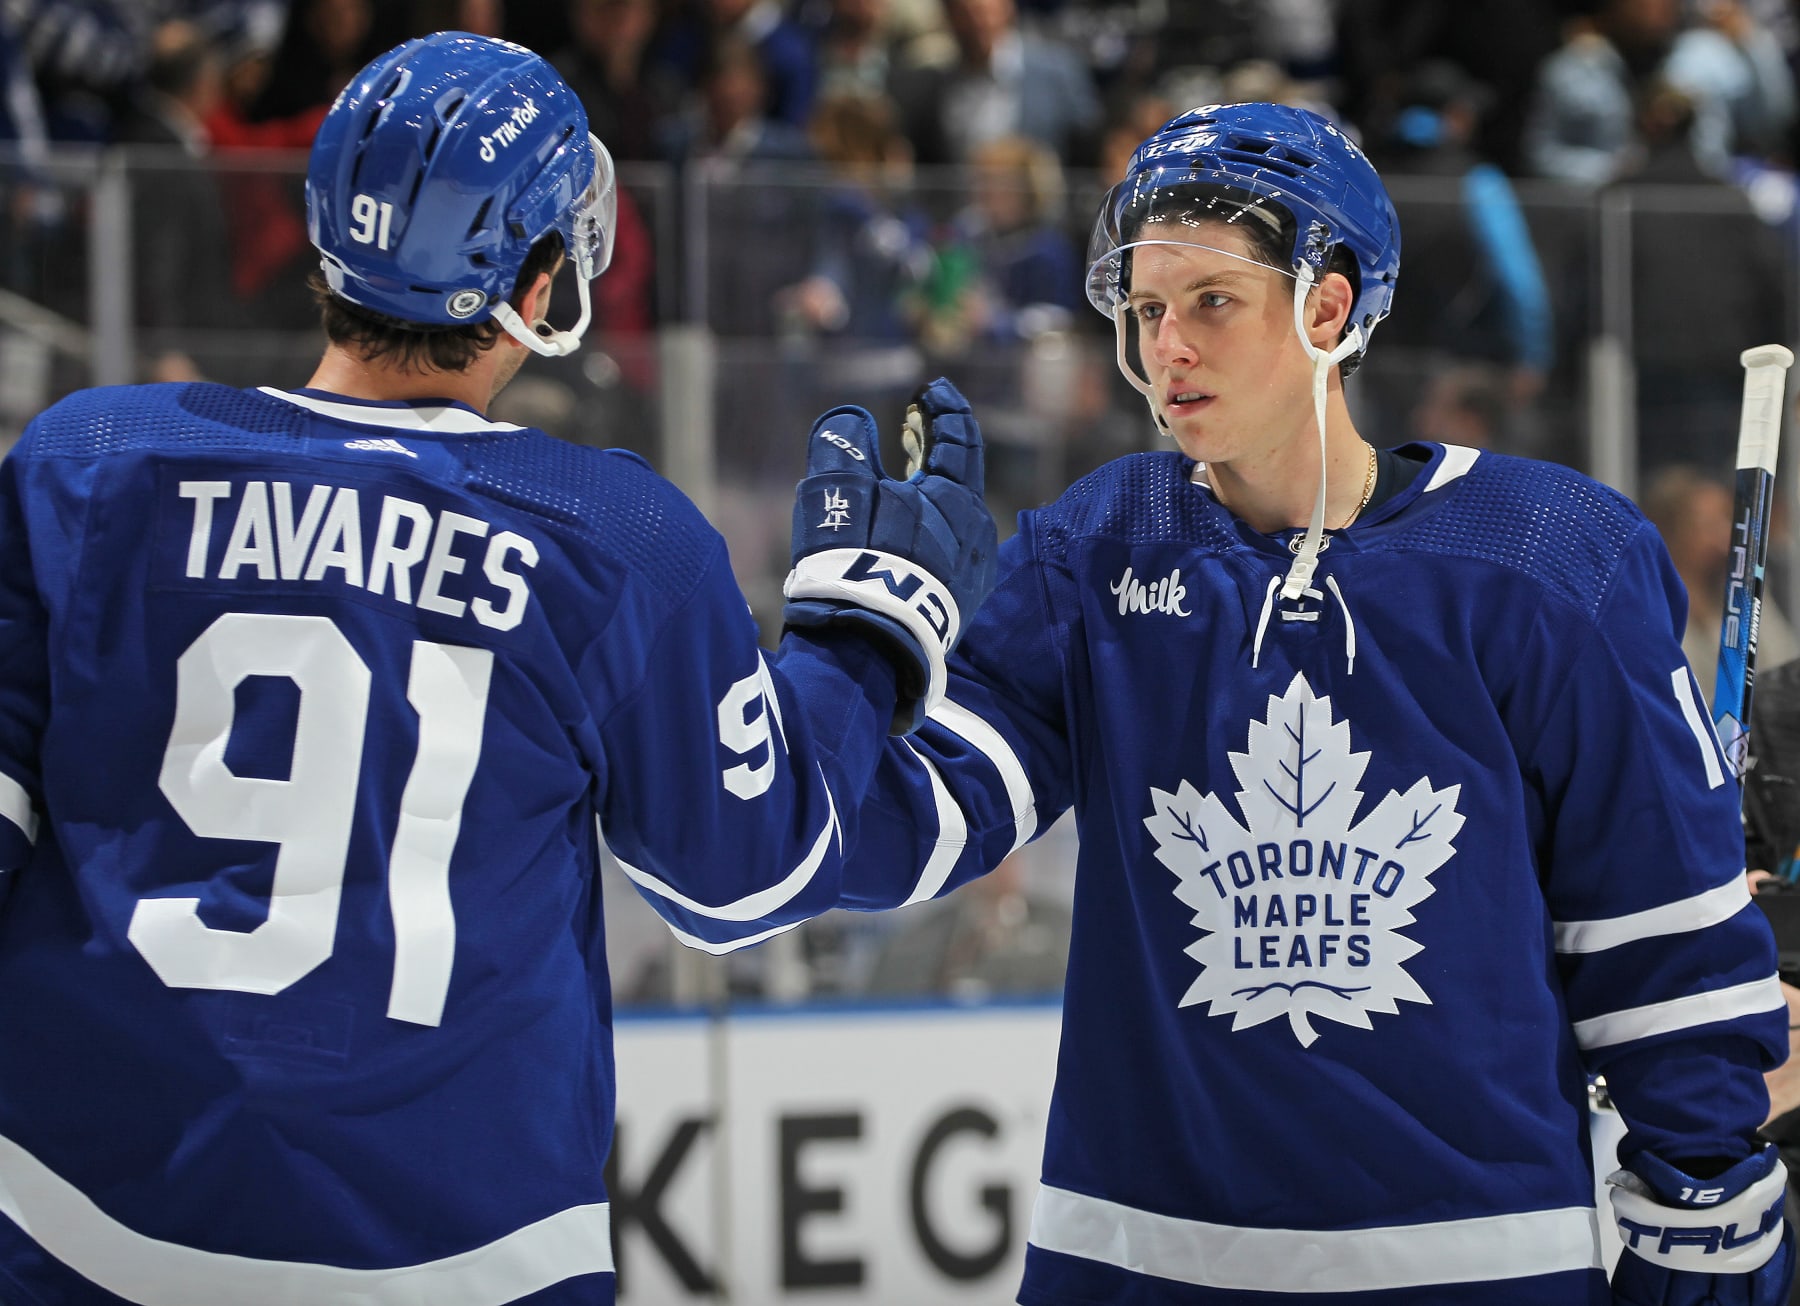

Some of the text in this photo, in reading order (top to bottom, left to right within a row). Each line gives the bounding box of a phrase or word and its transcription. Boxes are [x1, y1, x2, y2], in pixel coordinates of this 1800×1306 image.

[349, 194, 393, 250] 91
[820, 430, 865, 462] CCM
[179, 481, 539, 631] TAVARES
[1725, 507, 1751, 649] TRUE
[1110, 567, 1192, 617] Milk
[127, 612, 494, 1027] 91
[1200, 839, 1405, 899] TORONTO
[1234, 894, 1371, 928] MAPLE
[1234, 934, 1371, 969] LEAFS
[1680, 1187, 1724, 1204] 16
